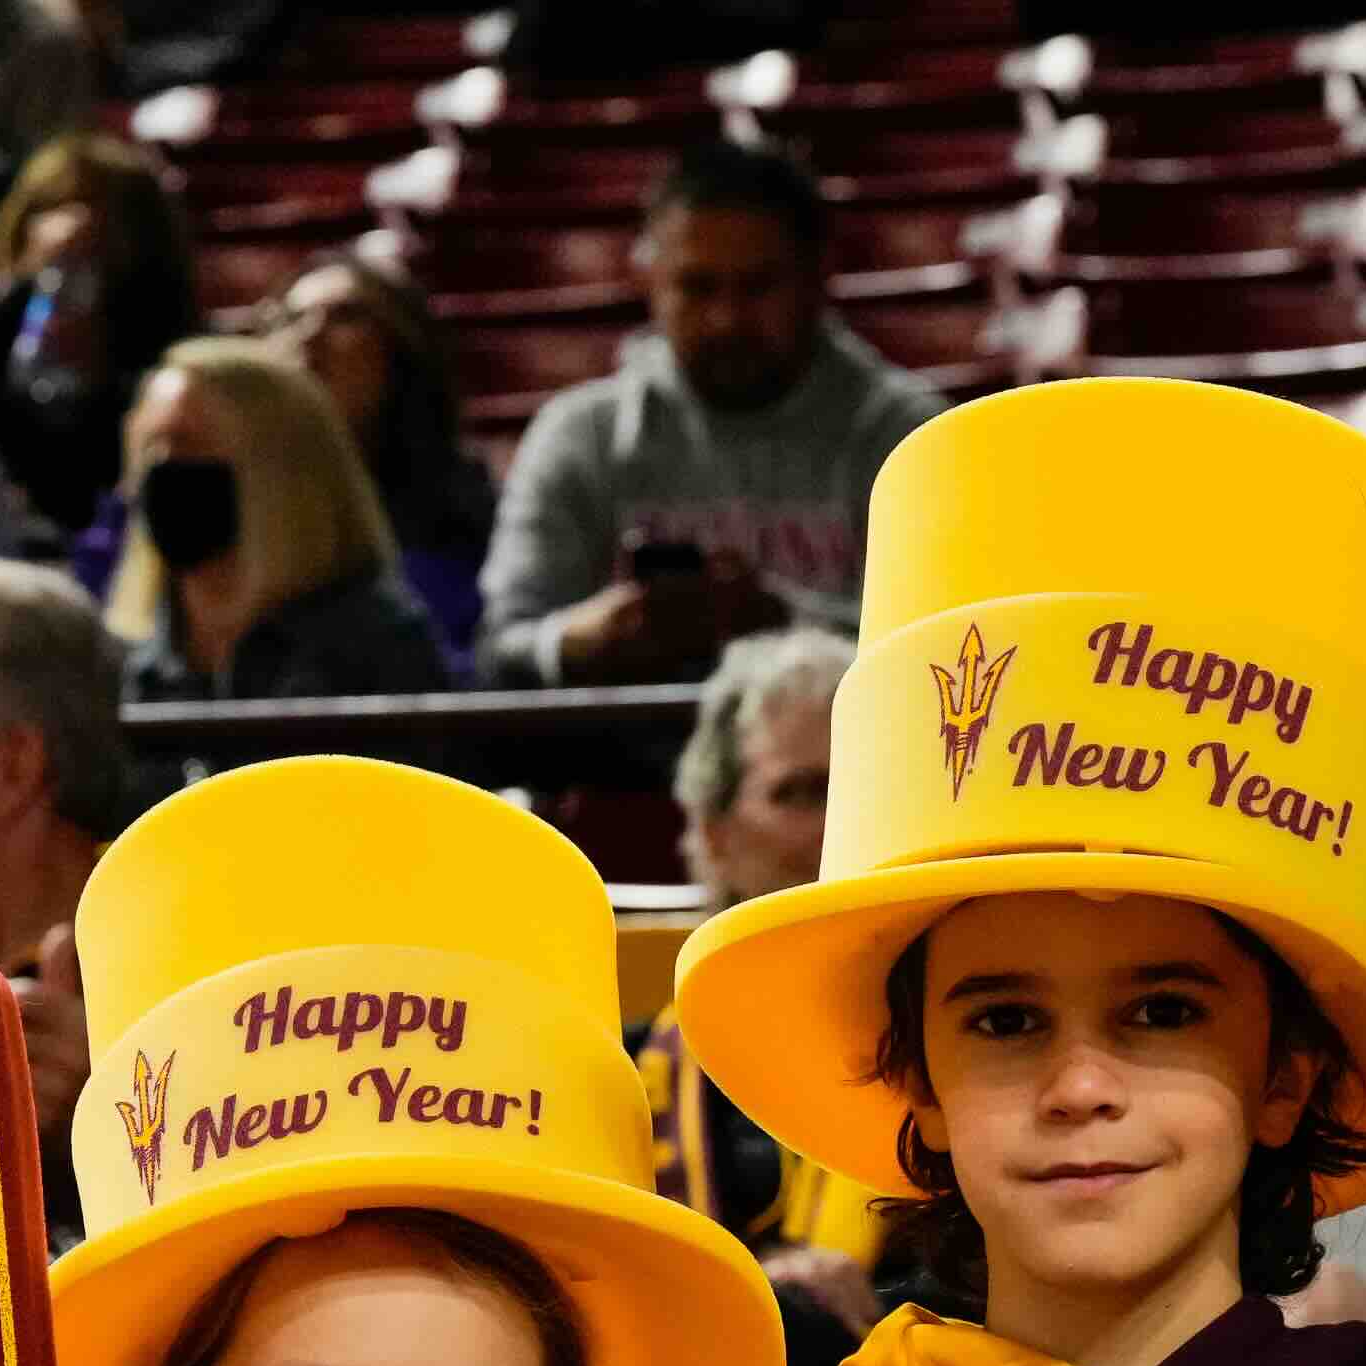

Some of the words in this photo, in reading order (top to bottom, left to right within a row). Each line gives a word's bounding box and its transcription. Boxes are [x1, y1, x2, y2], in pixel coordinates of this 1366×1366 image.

[1088, 622, 1312, 744] Happy
[1008, 723, 1166, 792] New
[1187, 742, 1353, 857] Year!
[233, 985, 467, 1053] Happy
[183, 1089, 328, 1172] New
[347, 1067, 542, 1136] Year!
